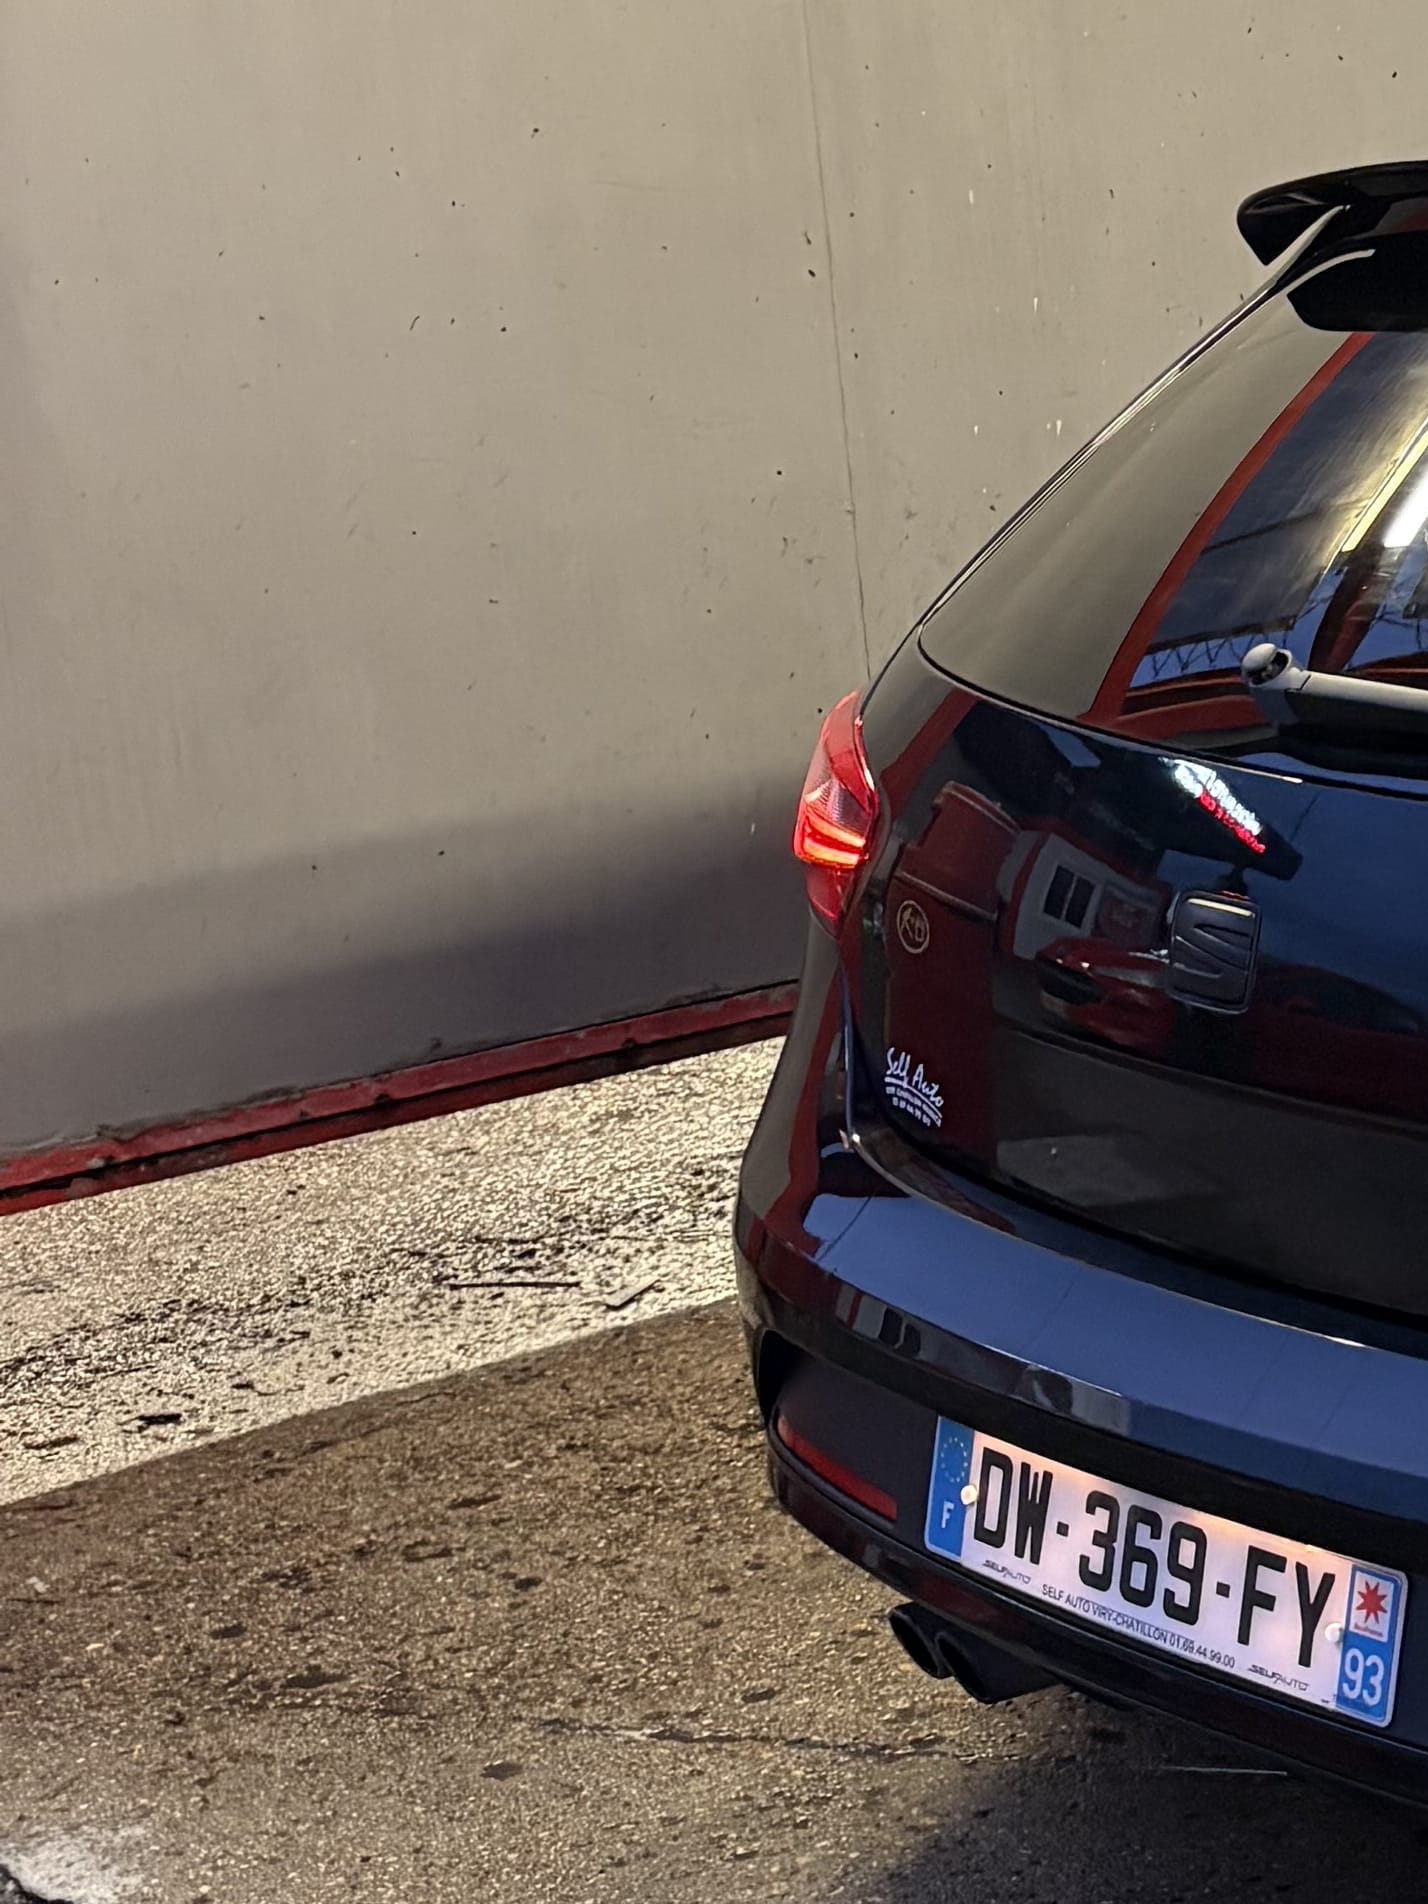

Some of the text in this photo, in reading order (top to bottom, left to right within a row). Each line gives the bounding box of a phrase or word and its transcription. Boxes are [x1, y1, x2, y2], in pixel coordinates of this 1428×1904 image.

[912, 1063, 945, 1108] Auto
[941, 1501, 954, 1529] F
[1042, 1583, 1064, 1601] SELF
[1065, 1594, 1091, 1613] AUTO
[1342, 1648, 1385, 1706] 93
